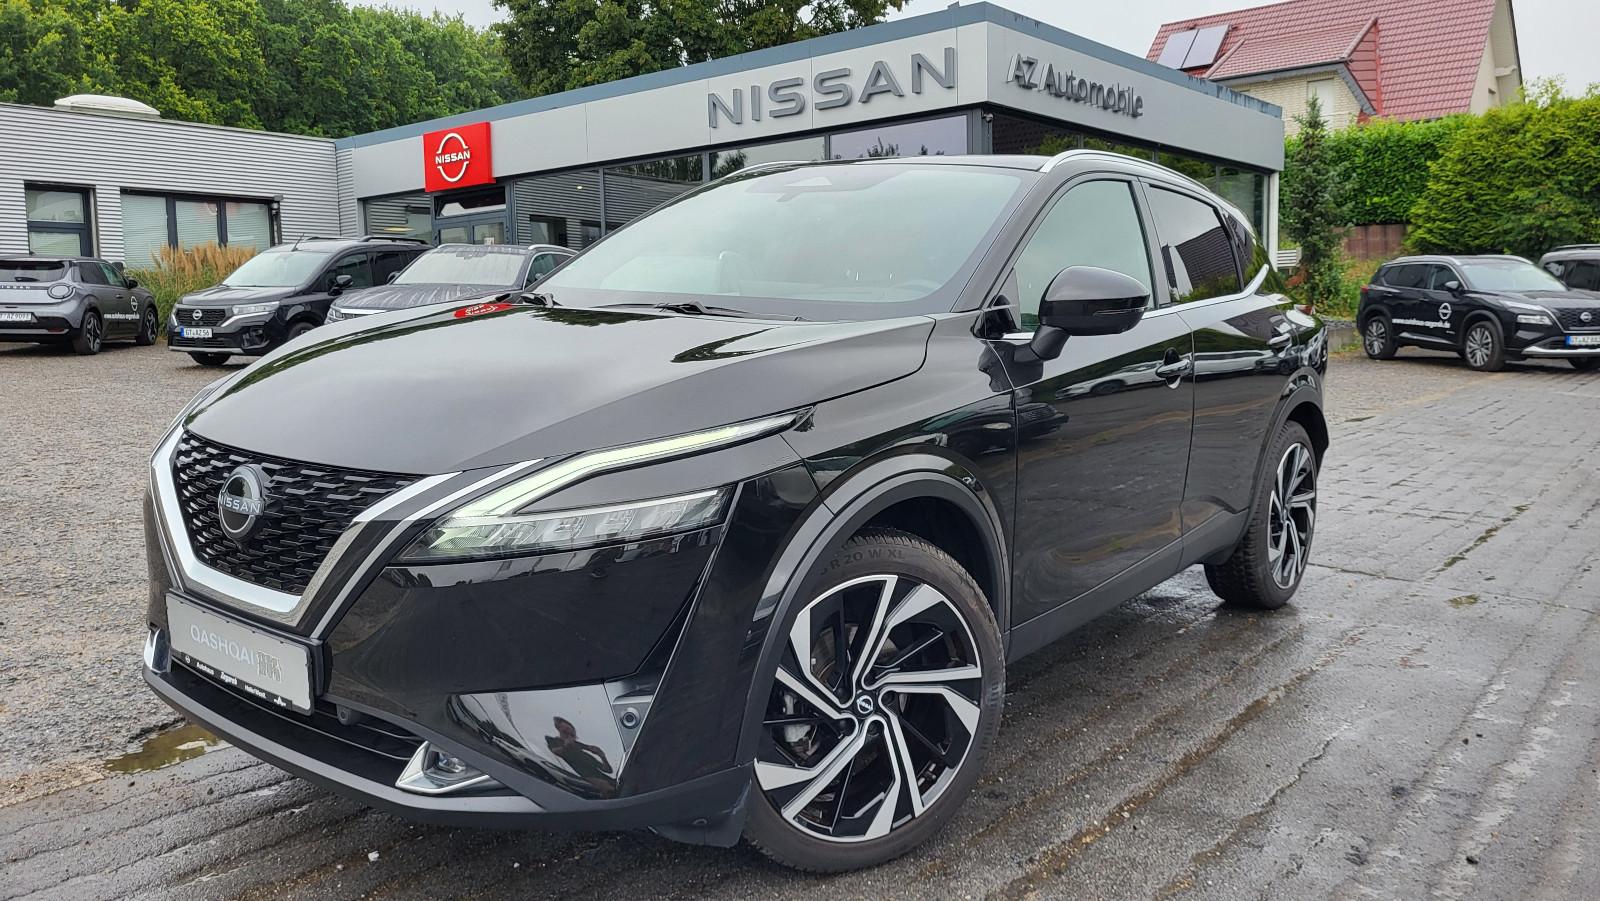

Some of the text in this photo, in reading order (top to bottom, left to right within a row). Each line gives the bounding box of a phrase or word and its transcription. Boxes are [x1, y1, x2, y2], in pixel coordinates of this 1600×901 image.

[708, 47, 955, 128] NISSAN
[1007, 53, 1143, 118] AZ Automobile
[435, 150, 470, 164] NISSAN
[220, 495, 261, 513] NISSAN
[843, 553, 863, 565] 20
[869, 549, 882, 559] W
[887, 548, 905, 560] XL
[190, 624, 254, 665] QASHQAI
